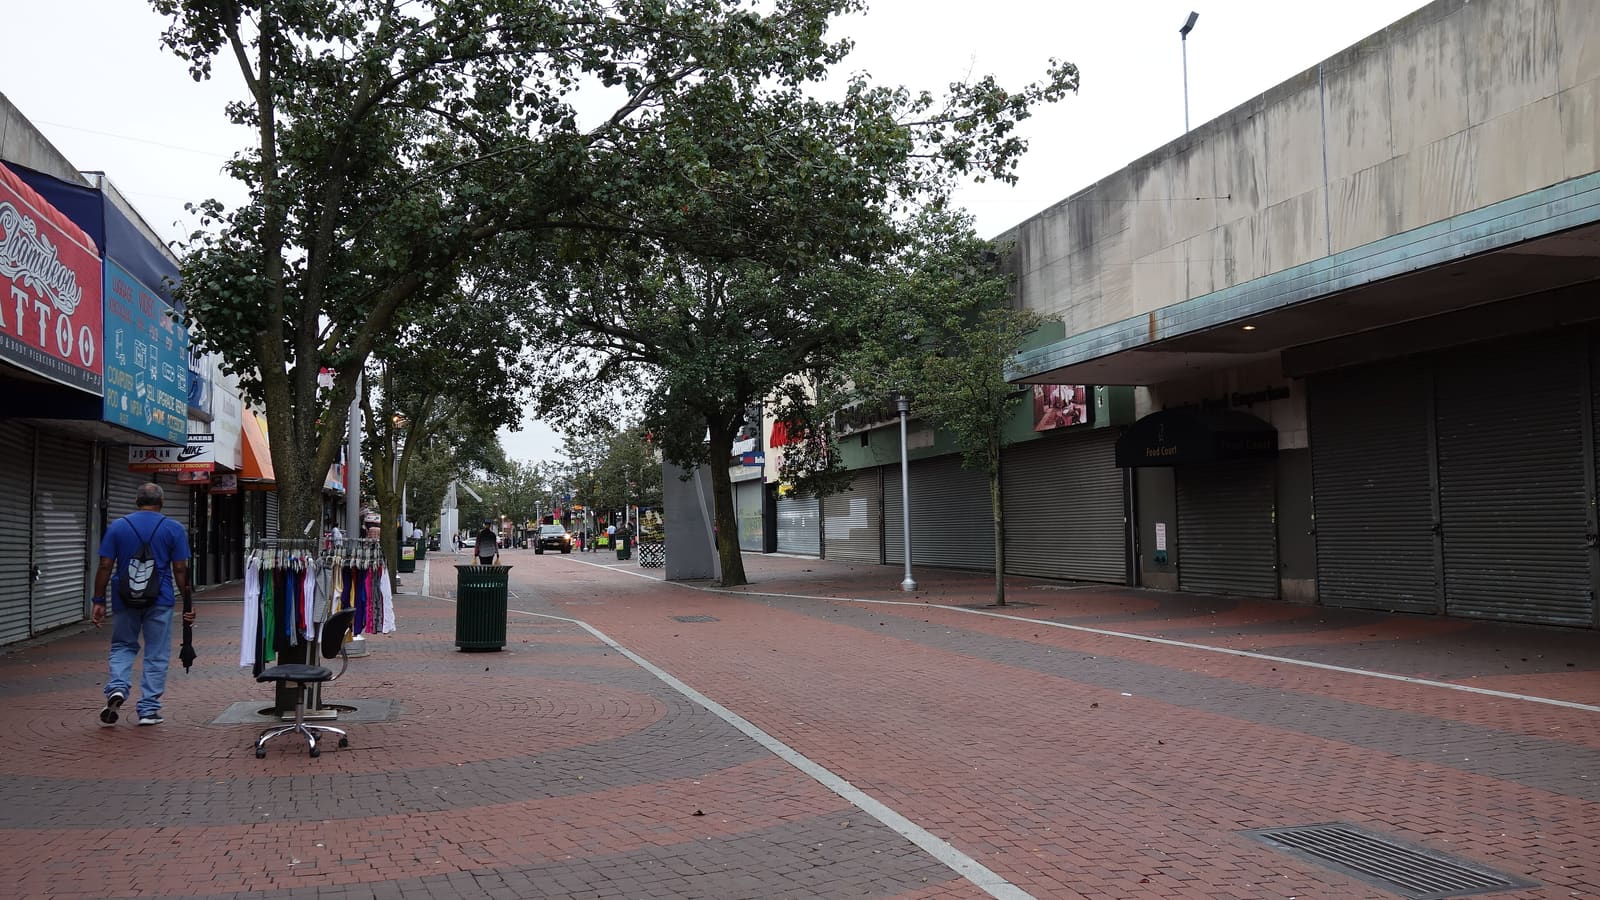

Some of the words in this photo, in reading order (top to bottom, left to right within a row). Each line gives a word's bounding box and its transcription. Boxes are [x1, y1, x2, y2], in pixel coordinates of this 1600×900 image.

[182, 445, 205, 455] NIKE
[1146, 447, 1160, 457] Food
[1161, 445, 1177, 456] Court
